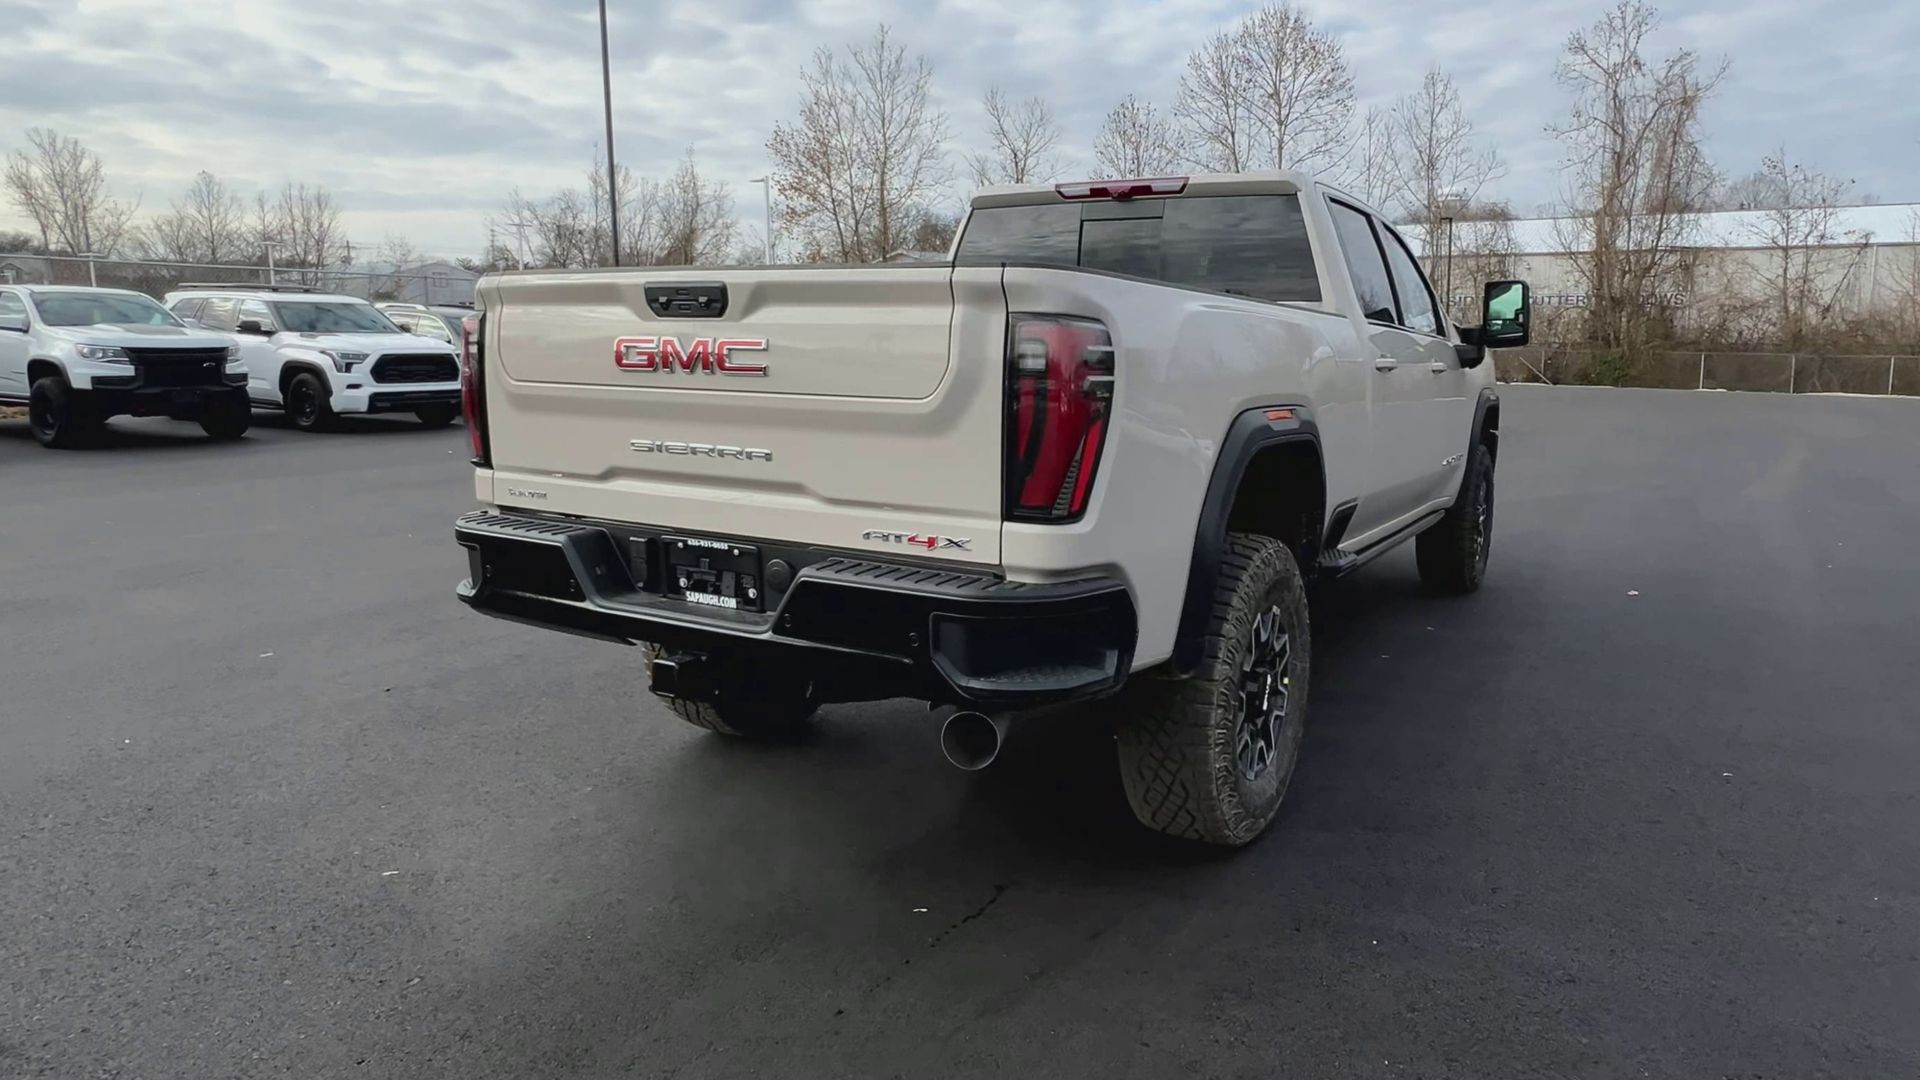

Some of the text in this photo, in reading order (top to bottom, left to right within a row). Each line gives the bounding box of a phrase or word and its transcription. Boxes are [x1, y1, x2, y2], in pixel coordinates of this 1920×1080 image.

[1530, 293, 1587, 306] UTTER
[614, 335, 769, 377] GMC
[630, 438, 773, 461] SIERRA
[862, 528, 973, 552] AT4X
[686, 591, 737, 609] SAPAUGH.COM
